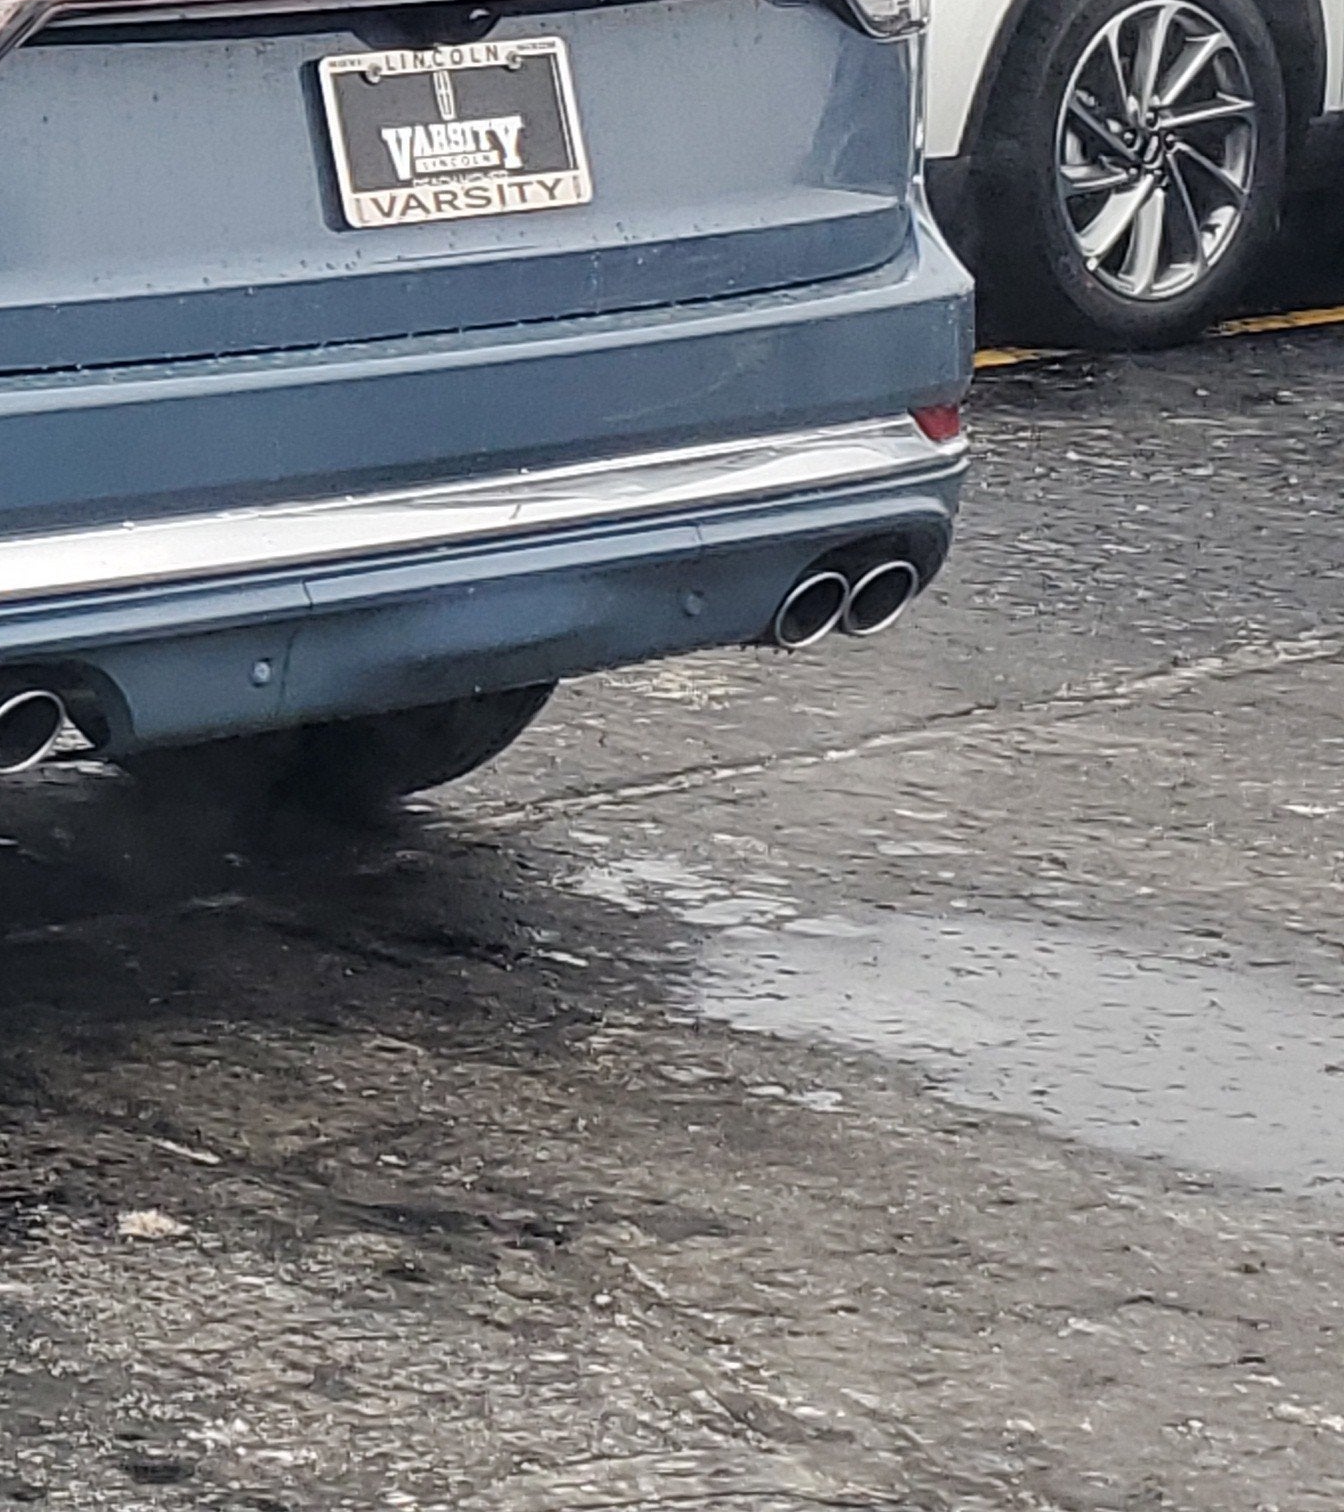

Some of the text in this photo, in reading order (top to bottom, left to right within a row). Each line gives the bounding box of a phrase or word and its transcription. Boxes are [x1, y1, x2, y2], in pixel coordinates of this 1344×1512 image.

[384, 43, 500, 72] LINCOLN
[381, 115, 525, 182] VARSITY
[422, 154, 493, 171] LINCOLN
[369, 177, 563, 219] VARSITY
